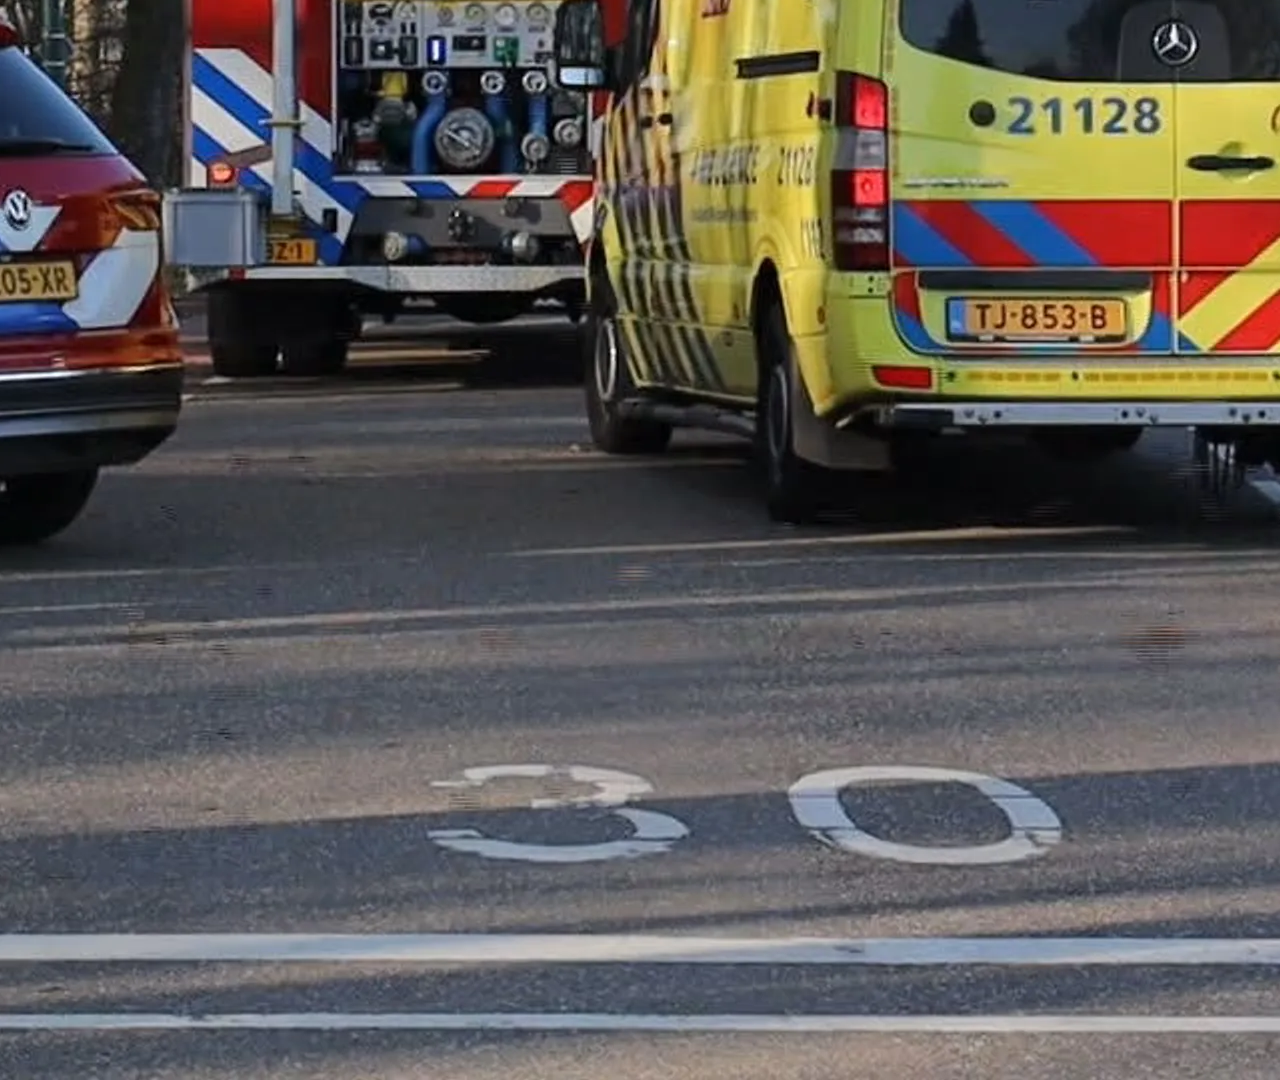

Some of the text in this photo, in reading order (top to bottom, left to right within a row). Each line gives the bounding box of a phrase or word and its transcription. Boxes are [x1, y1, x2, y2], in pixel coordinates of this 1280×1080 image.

[1007, 96, 1161, 135] 21128
[777, 145, 816, 186] 21128
[975, 303, 1108, 330] TJ-853-B
[426, 764, 1062, 864] 30
